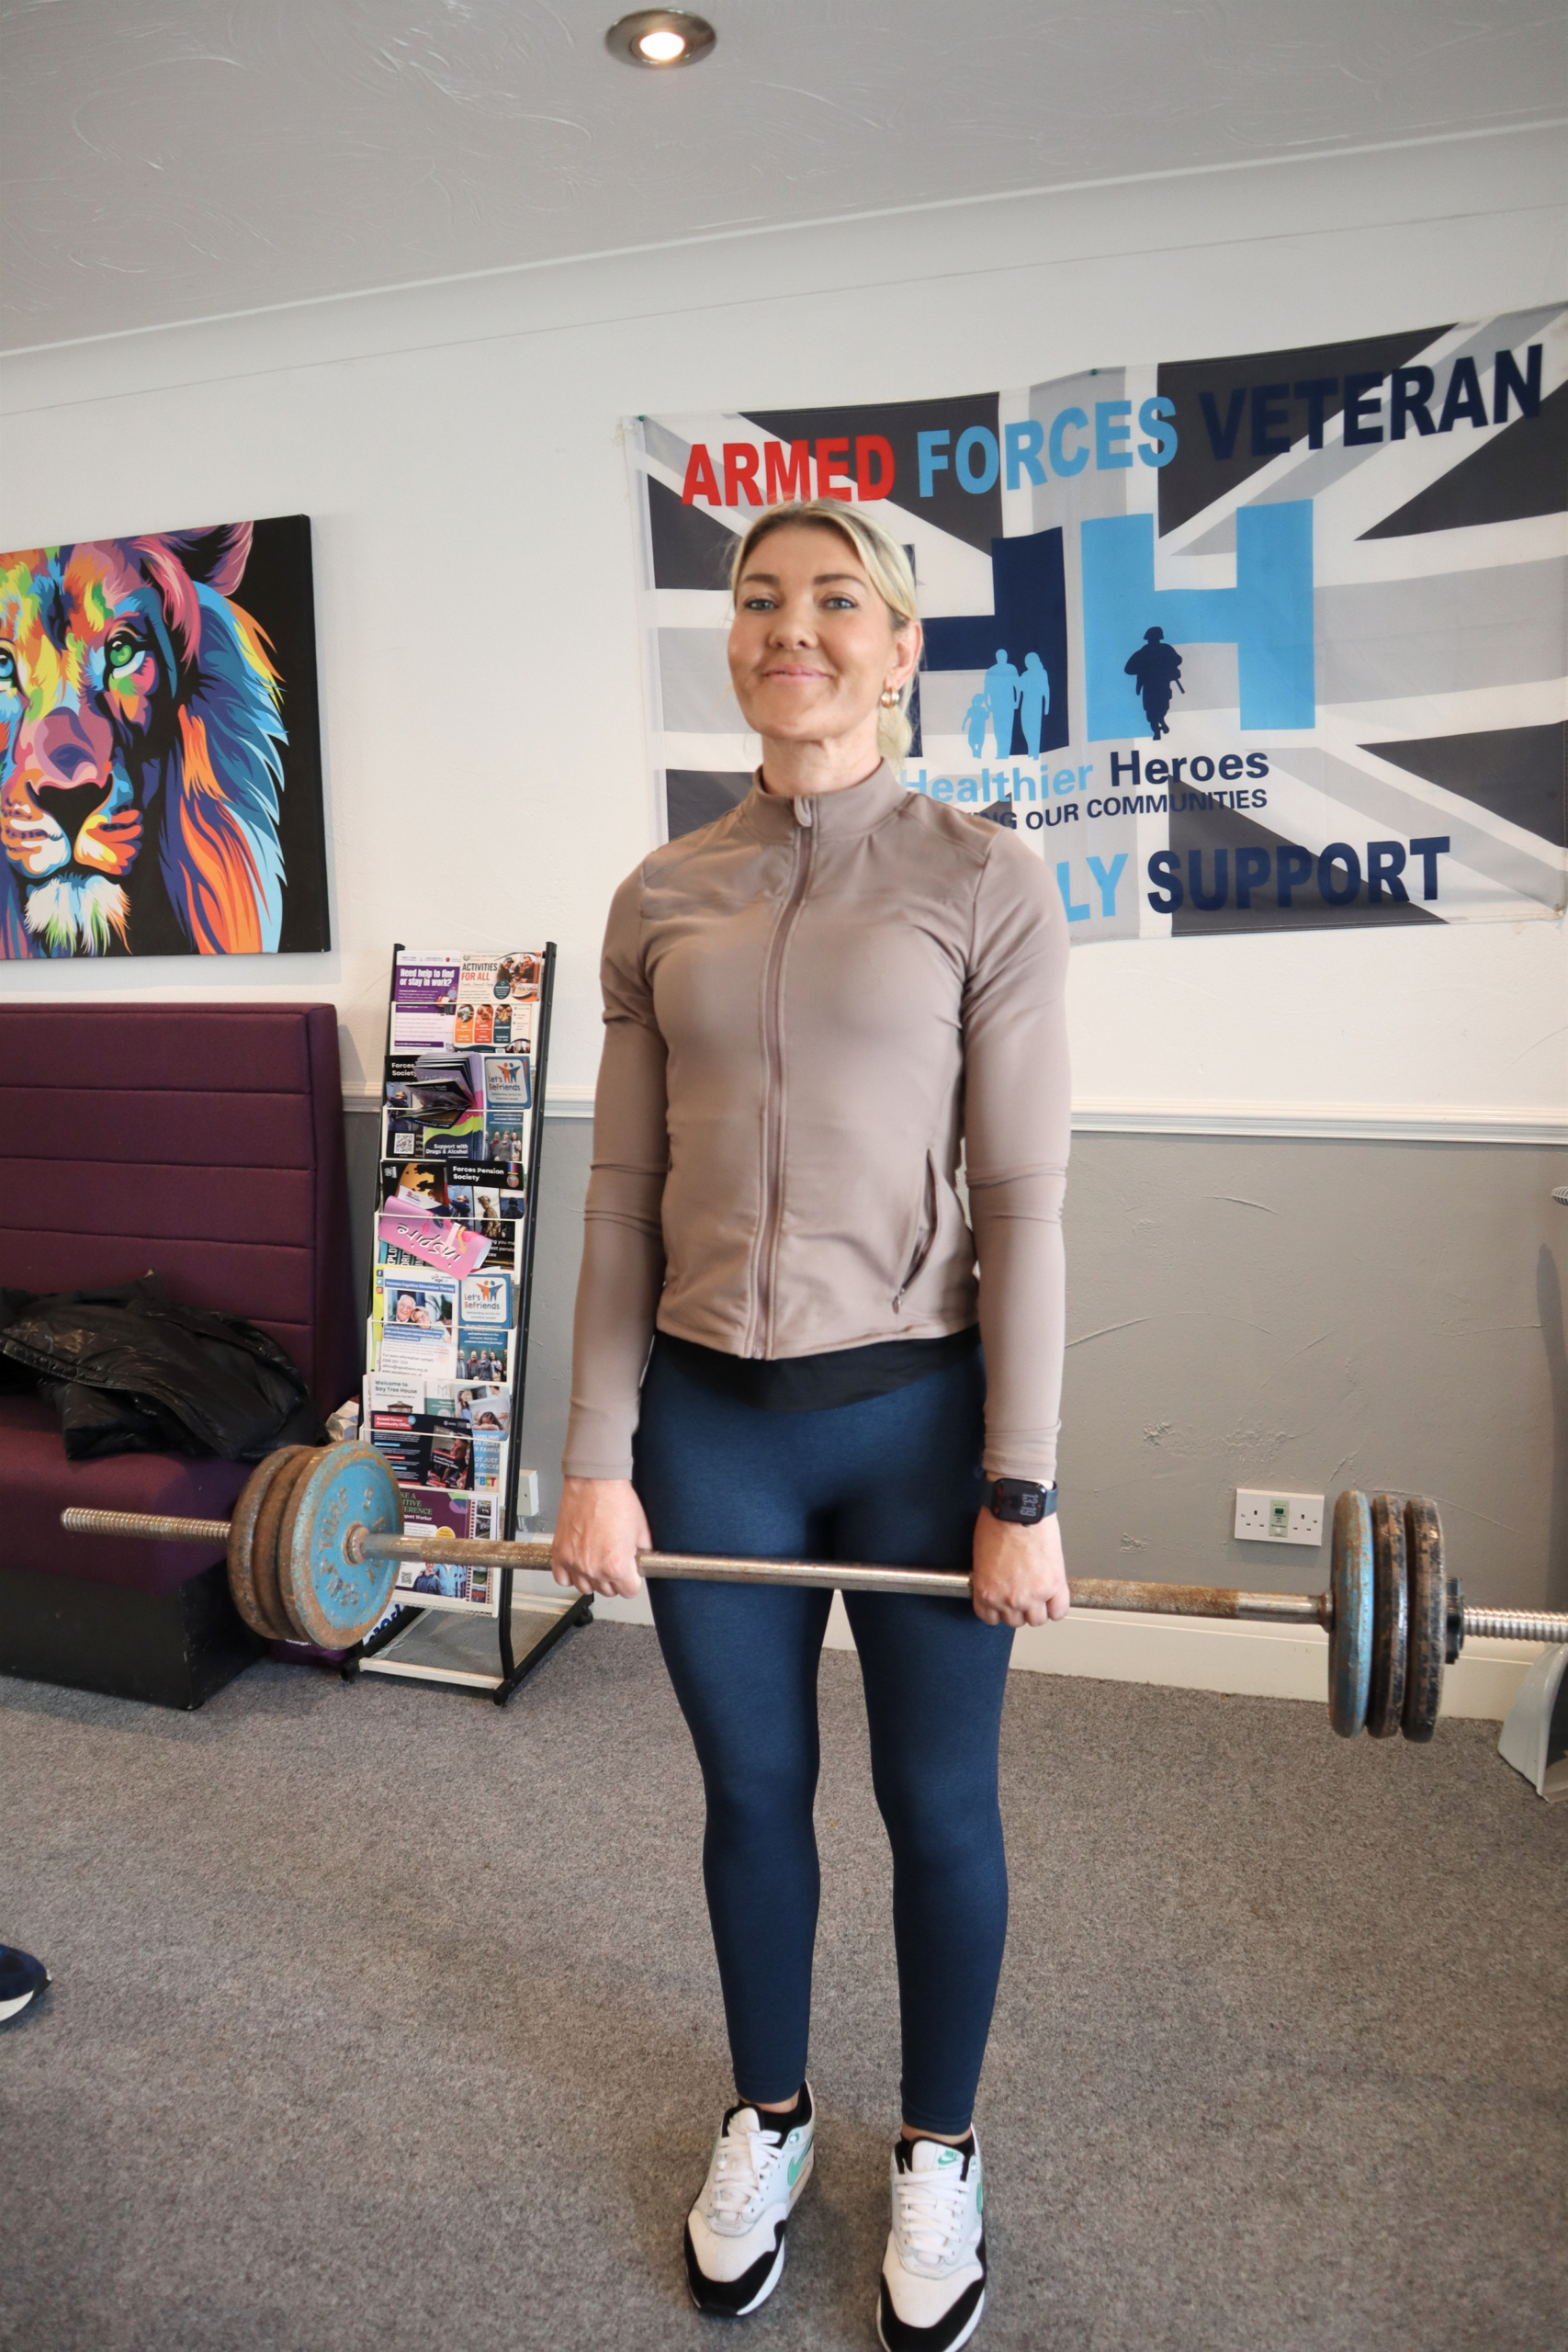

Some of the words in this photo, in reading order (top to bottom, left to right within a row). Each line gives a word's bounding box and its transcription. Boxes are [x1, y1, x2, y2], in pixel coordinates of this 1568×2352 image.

[682, 435, 895, 506] ARMED
[917, 396, 1179, 497] FORCES
[1199, 344, 1543, 460] VETERAN
[899, 763, 1094, 803] Healthier
[1110, 750, 1269, 786] Heroes
[1025, 803, 1080, 831] OUR
[1087, 788, 1268, 819] COMMUNITIES
[1147, 836, 1451, 914] SUPPORT
[462, 963, 498, 971] ACTIVITIES
[400, 968, 417, 978] Need
[417, 969, 433, 979] help
[433, 969, 441, 978] to
[441, 969, 456, 978] find
[461, 972, 476, 981] FOR
[477, 972, 491, 981] ALL
[408, 978, 423, 988] stay
[423, 978, 431, 987] in
[431, 978, 453, 987] work?
[489, 1083, 521, 1091] BeFriends
[453, 1173, 480, 1182] Society
[396, 1222, 462, 1269] inspire
[464, 1301, 501, 1310] BeFriends
[402, 1499, 423, 1508] ITIVE
[1020, 1493, 1040, 1517] 13:19
[404, 1507, 434, 1516] ERENCE
